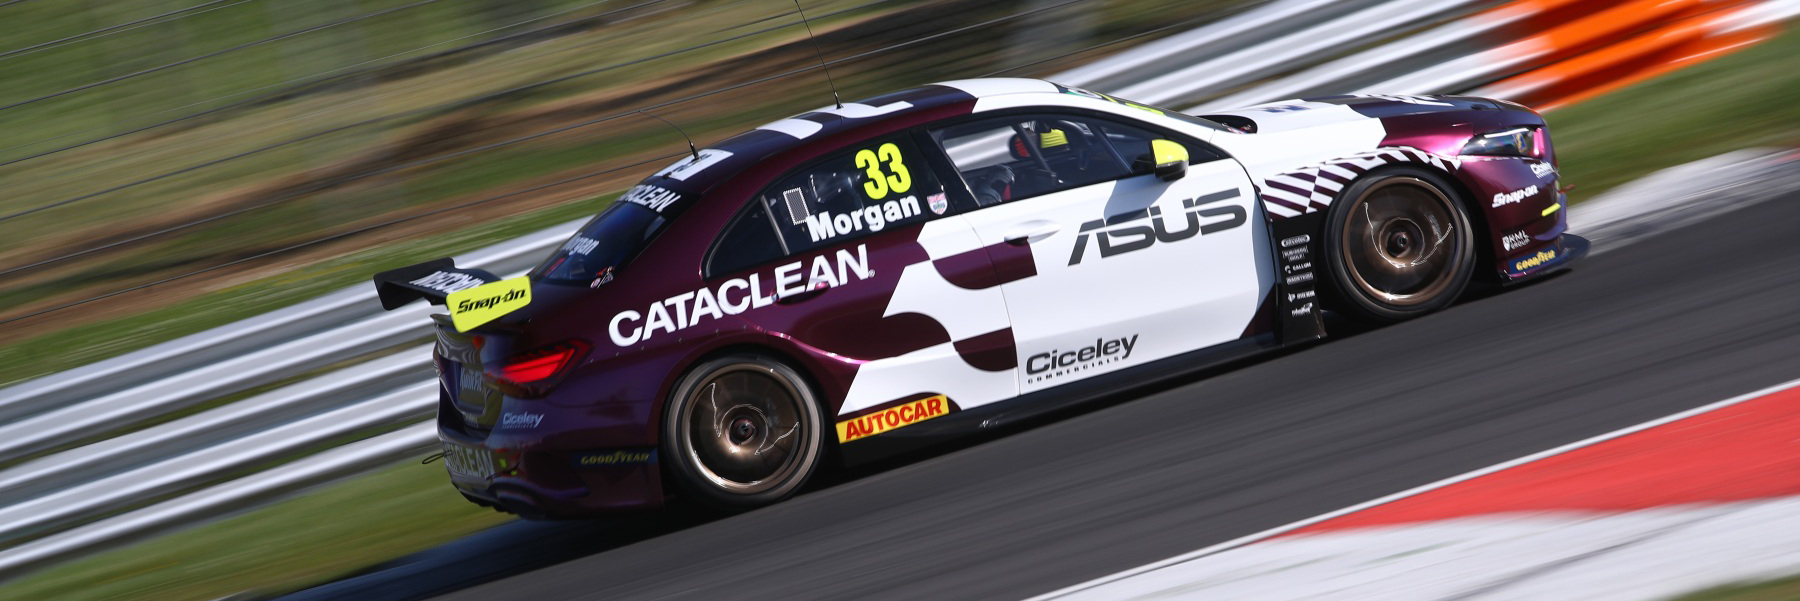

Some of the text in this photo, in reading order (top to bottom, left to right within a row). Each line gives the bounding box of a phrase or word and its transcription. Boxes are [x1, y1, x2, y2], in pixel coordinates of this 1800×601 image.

[855, 142, 911, 199] 33
[1492, 184, 1538, 208] Snap-on
[806, 194, 921, 242] Morgan
[1067, 187, 1247, 267] ASUS
[1026, 334, 1139, 375] Ciceley
[1027, 356, 1120, 384] COMMERCIALS
[846, 397, 942, 441] AUTOCAR
[581, 450, 650, 465] GOODYEAR
